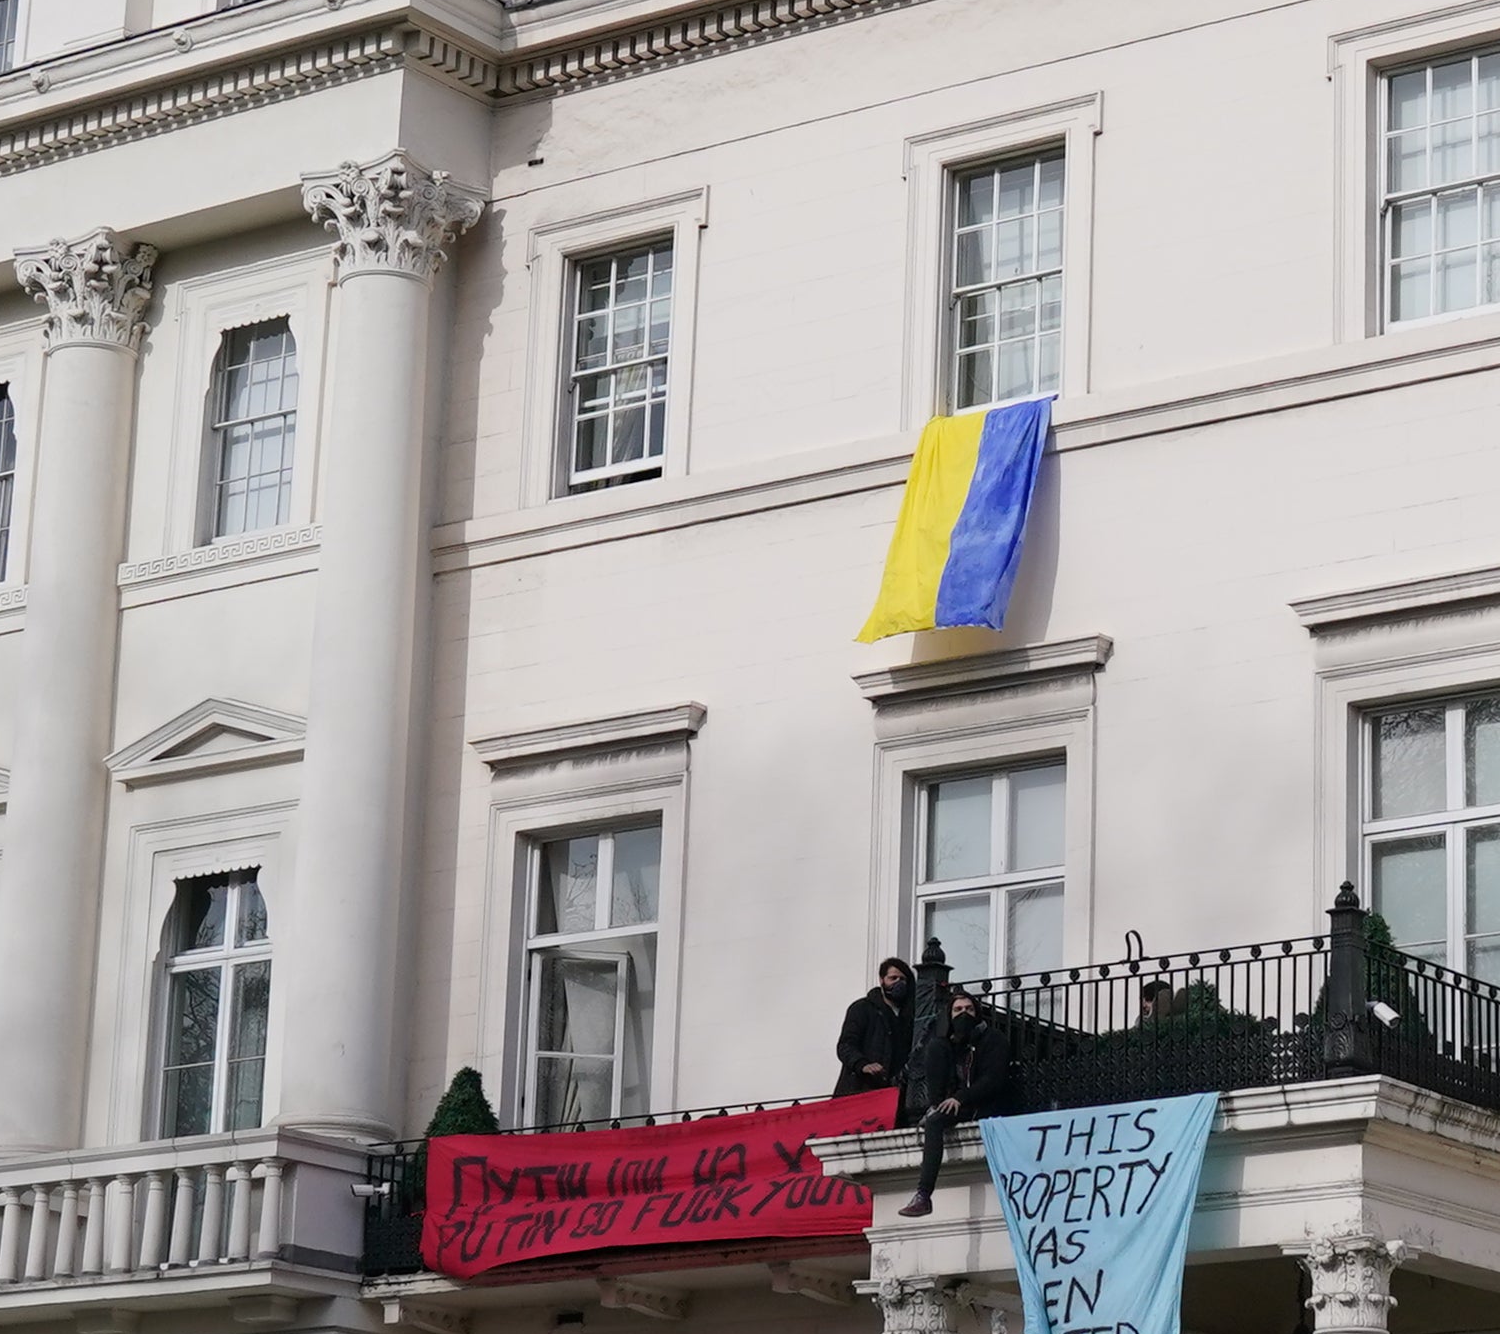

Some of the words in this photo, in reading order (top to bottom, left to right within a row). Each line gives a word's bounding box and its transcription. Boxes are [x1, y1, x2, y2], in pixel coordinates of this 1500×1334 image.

[1027, 1107, 1158, 1162] THIS
[437, 1202, 571, 1266] PUTIN
[570, 1199, 625, 1238] GO
[631, 1183, 752, 1233] FUCK
